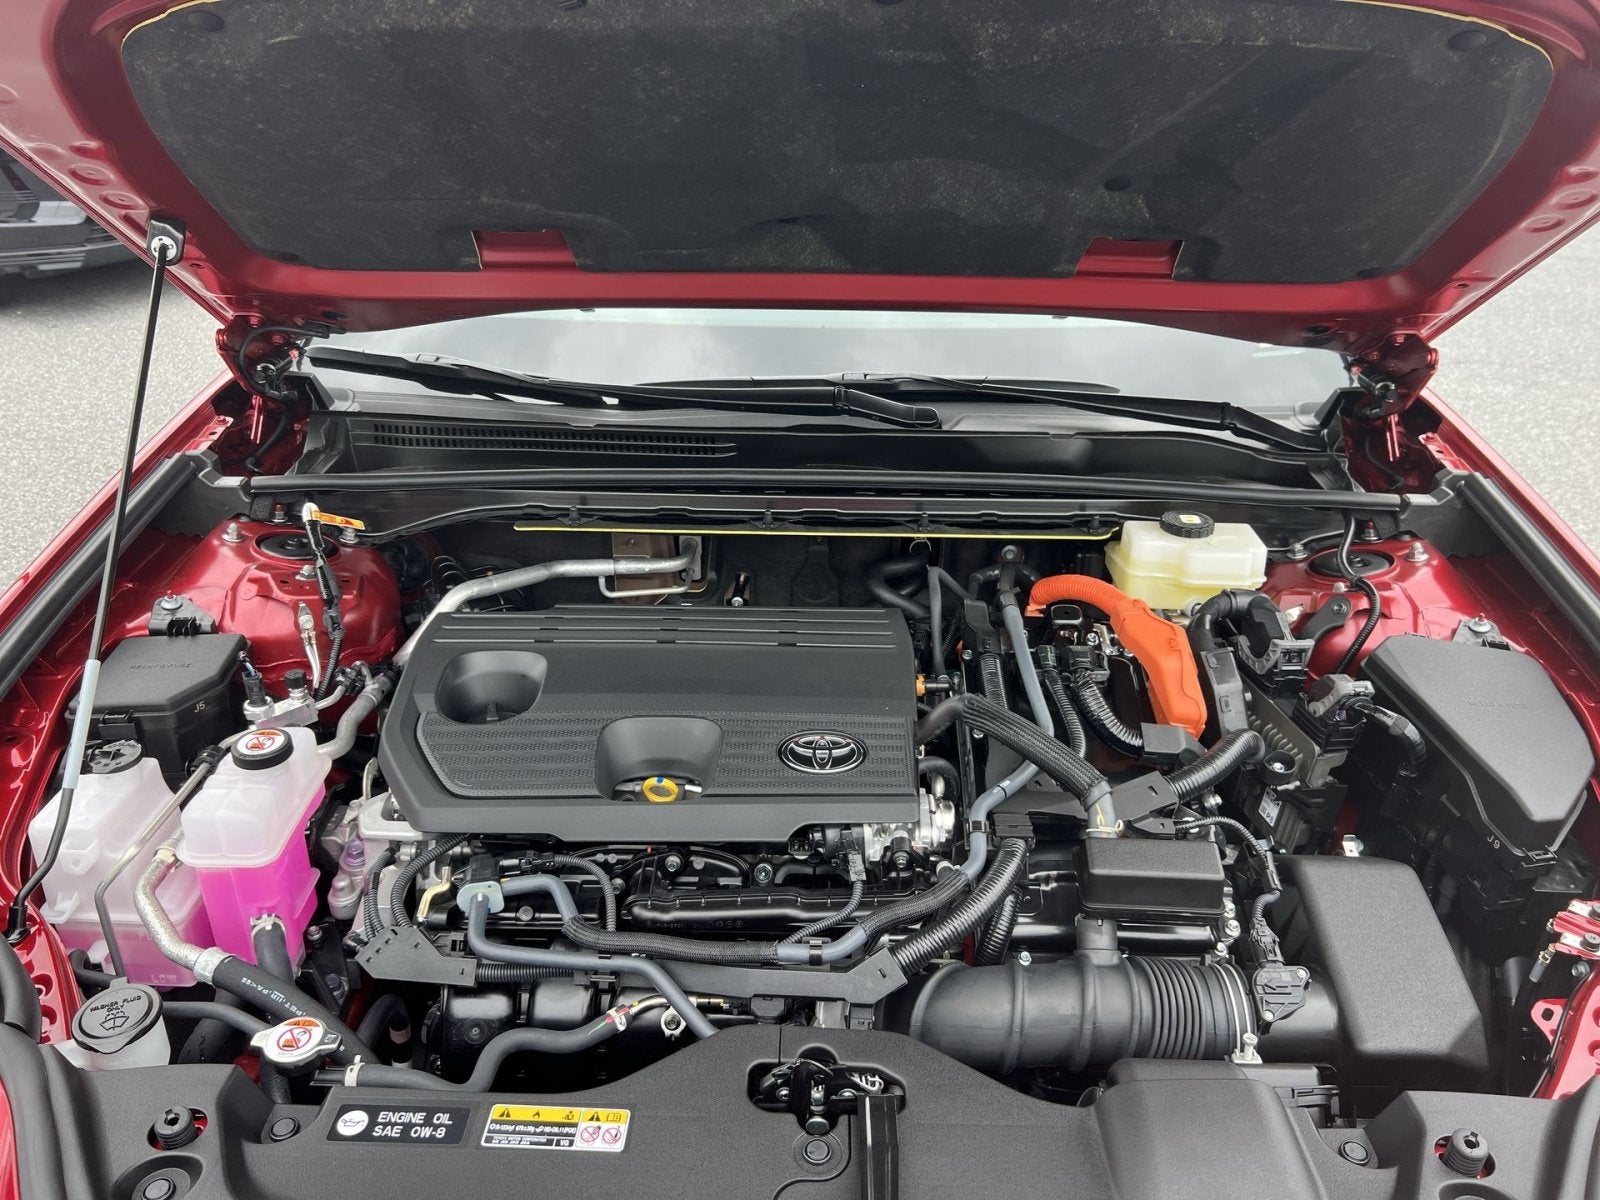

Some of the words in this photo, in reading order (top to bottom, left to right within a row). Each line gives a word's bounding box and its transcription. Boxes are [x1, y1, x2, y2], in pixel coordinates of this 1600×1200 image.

[194, 700, 206, 713] J5
[1486, 833, 1501, 849] J9
[150, 974, 177, 983] LOW
[89, 1000, 119, 1013] WASHER
[122, 995, 142, 1005] FLUID
[106, 1004, 125, 1013] ONLY
[377, 1111, 426, 1124] ENGINE
[432, 1113, 453, 1125] OIL
[372, 1125, 403, 1137] SAE
[410, 1126, 446, 1139] 0W-8
